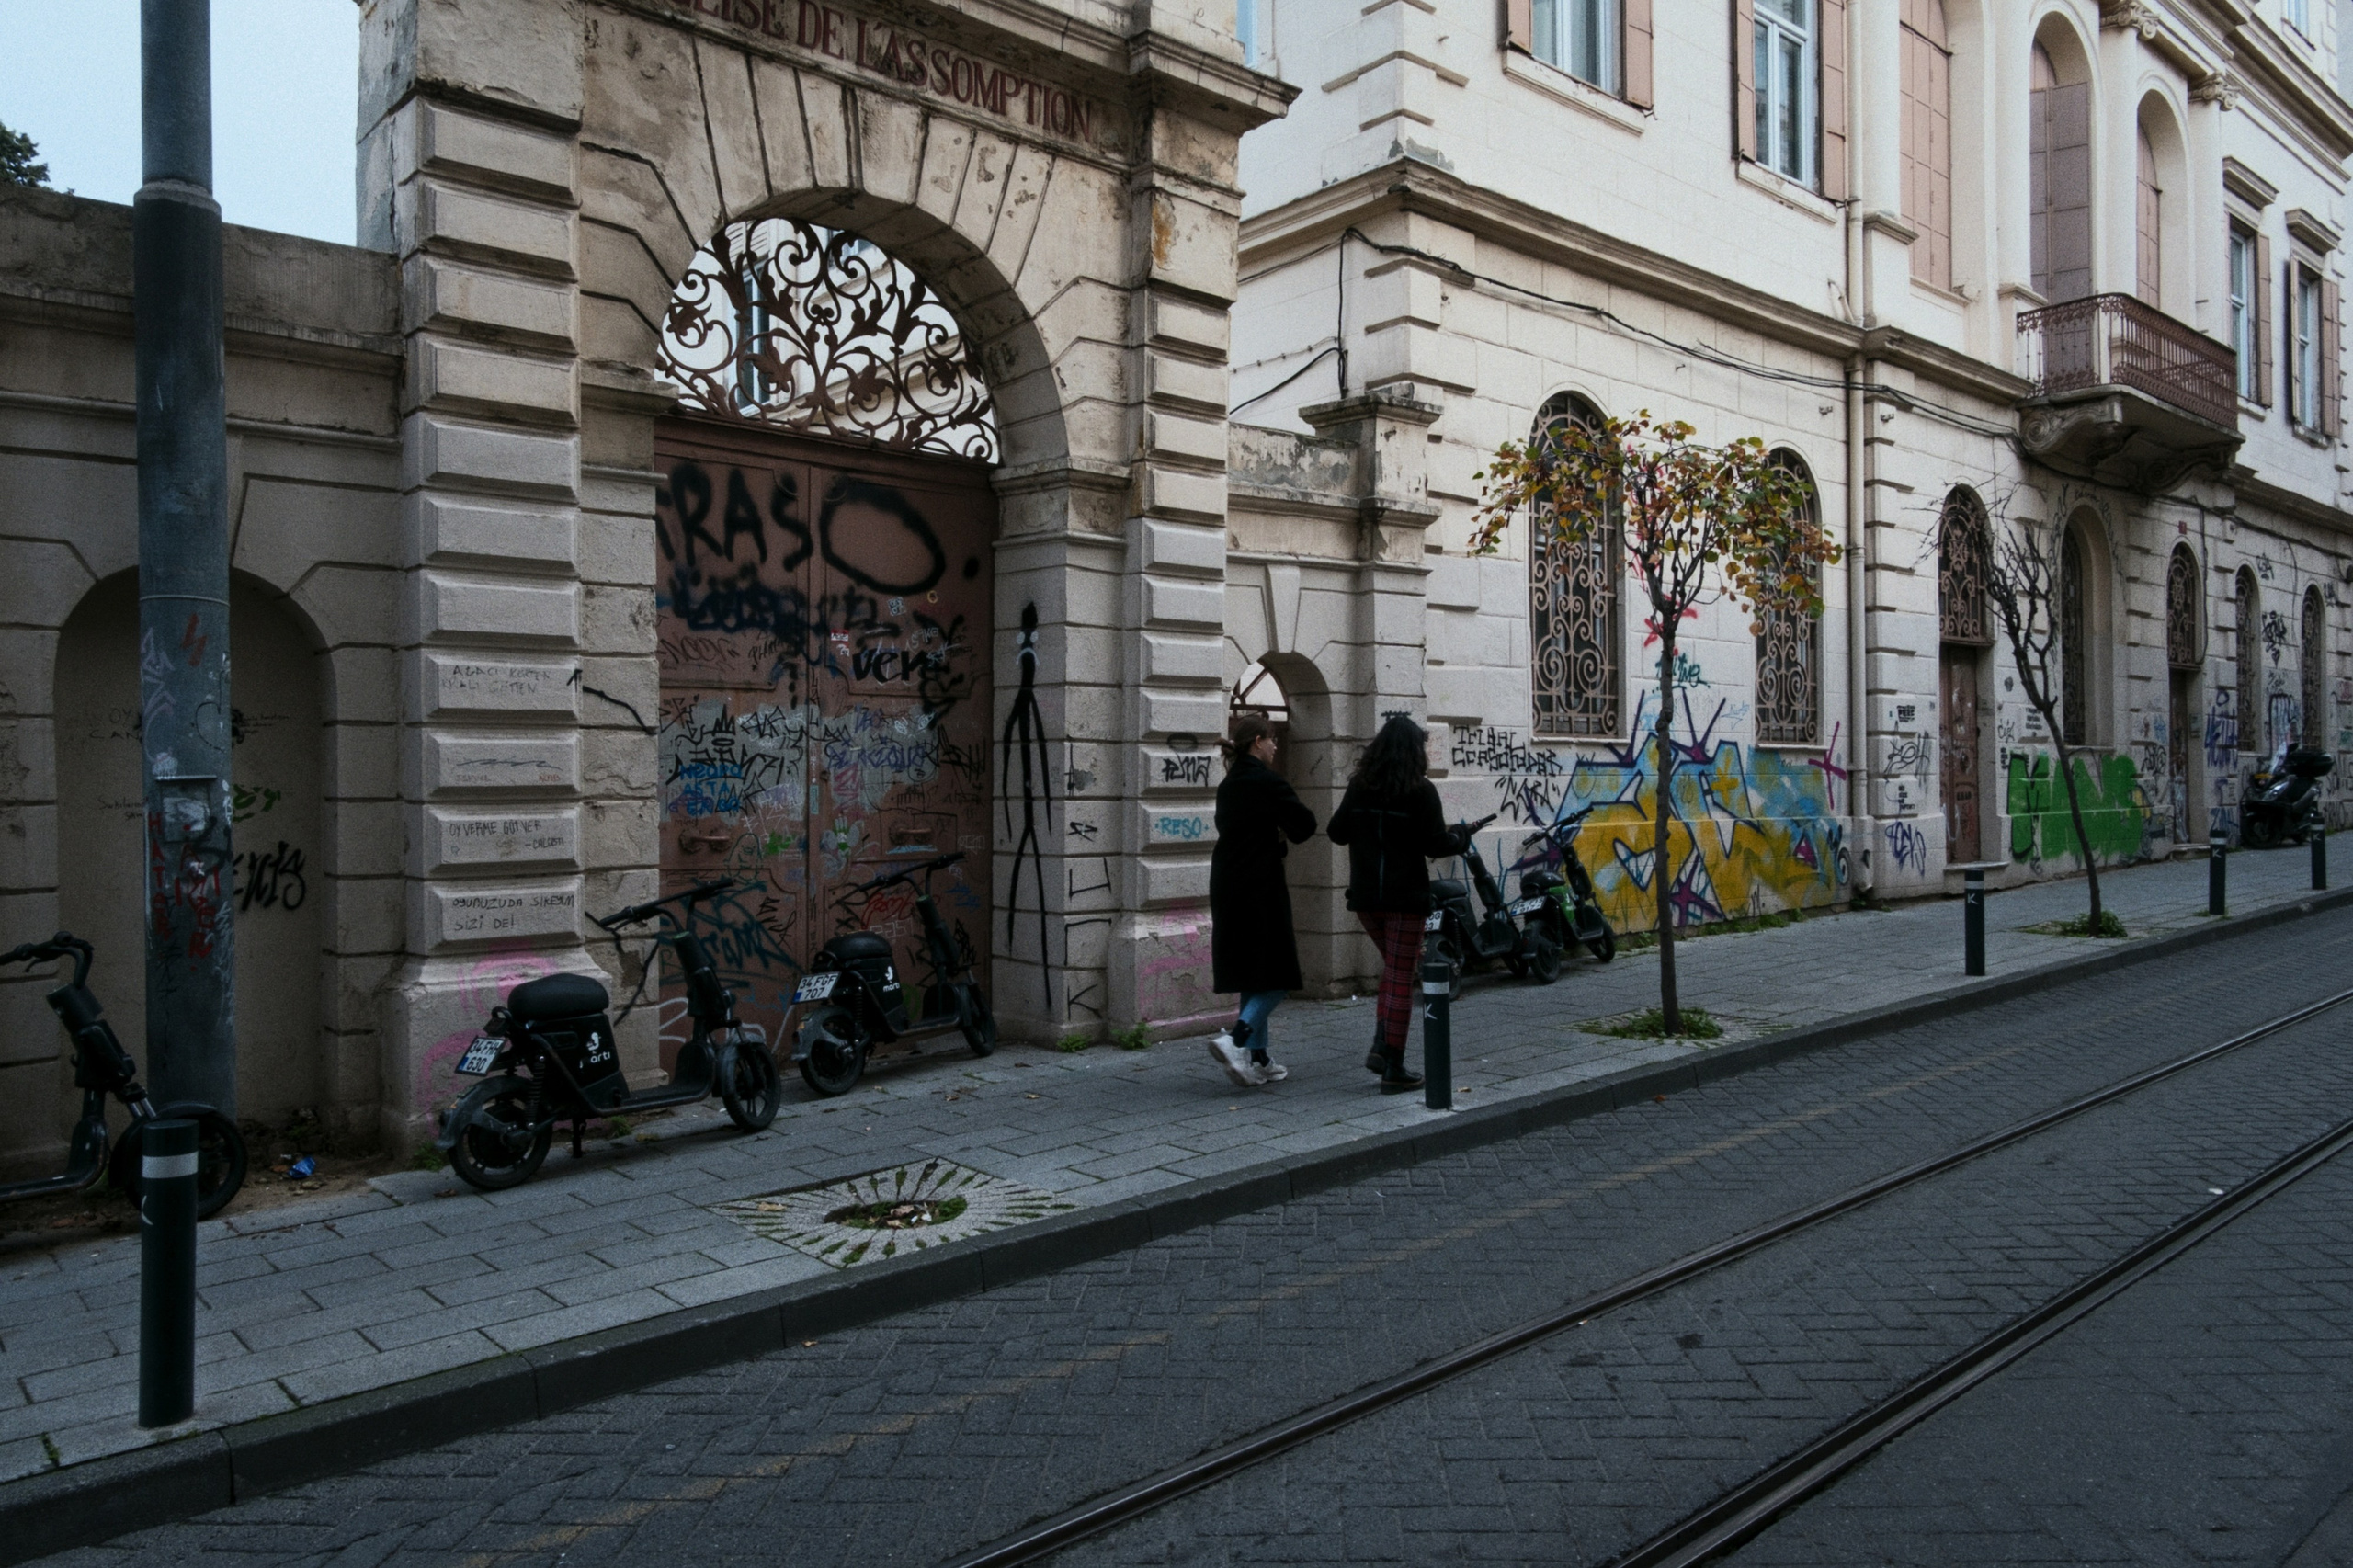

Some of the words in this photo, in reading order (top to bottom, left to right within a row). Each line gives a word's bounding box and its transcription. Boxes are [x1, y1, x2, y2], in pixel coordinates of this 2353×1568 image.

[796, 0, 844, 60] DE
[800, 976, 813, 990] 34
[813, 974, 838, 987] FGF
[804, 987, 825, 1000] 707
[469, 1038, 483, 1053] 34
[465, 1056, 487, 1073] 630
